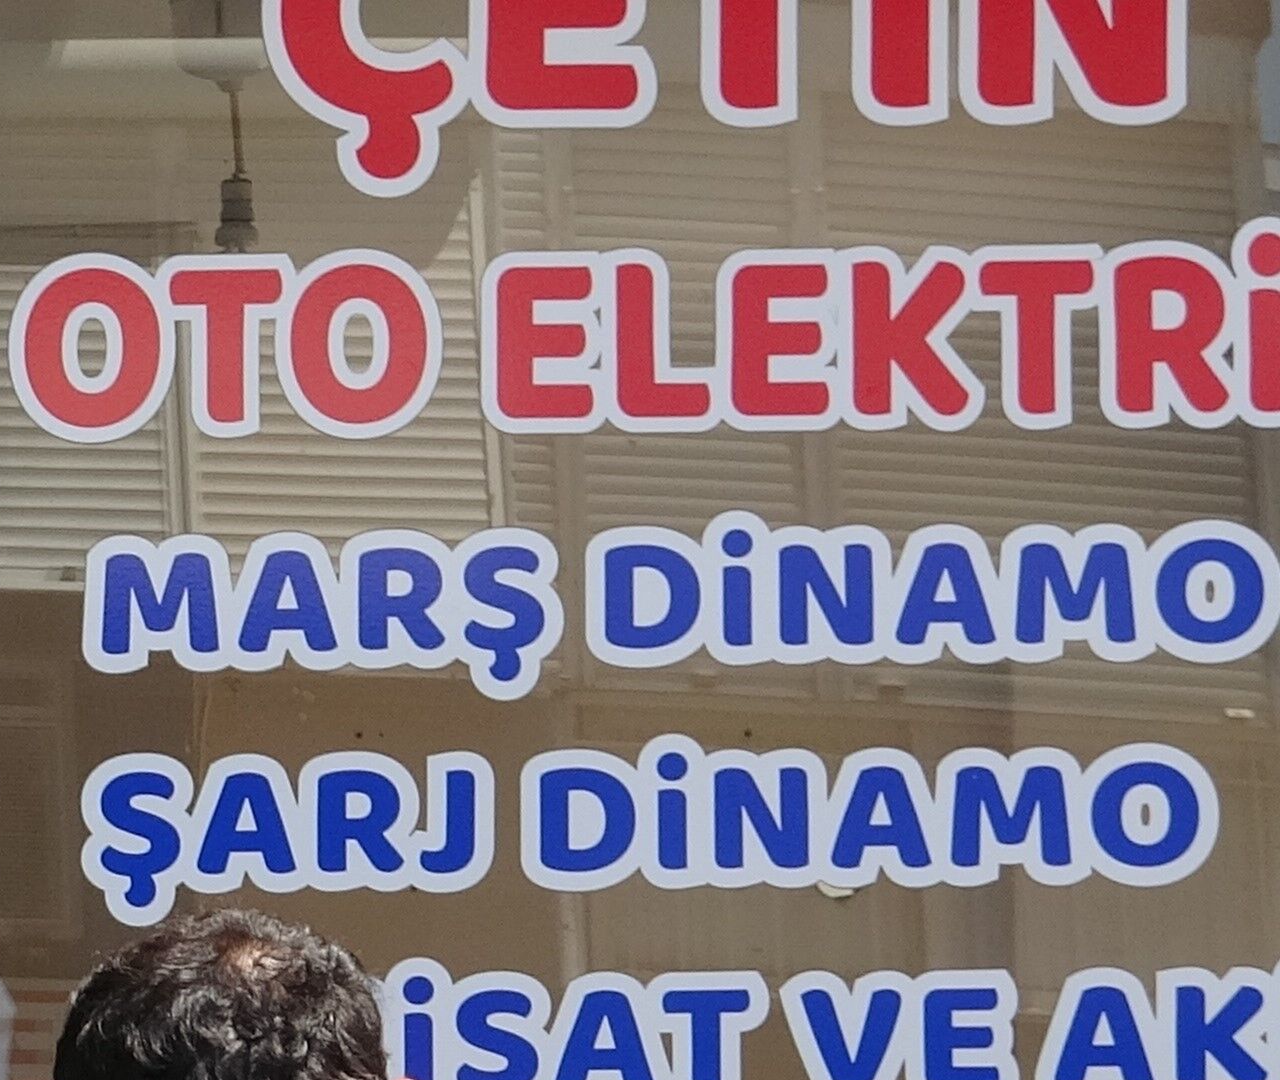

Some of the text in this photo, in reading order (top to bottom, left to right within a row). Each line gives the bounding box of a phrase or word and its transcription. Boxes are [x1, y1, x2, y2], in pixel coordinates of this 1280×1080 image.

[23, 264, 428, 428] OTO
[101, 547, 544, 683] MARŞ
[99, 770, 475, 908] ŞARJ
